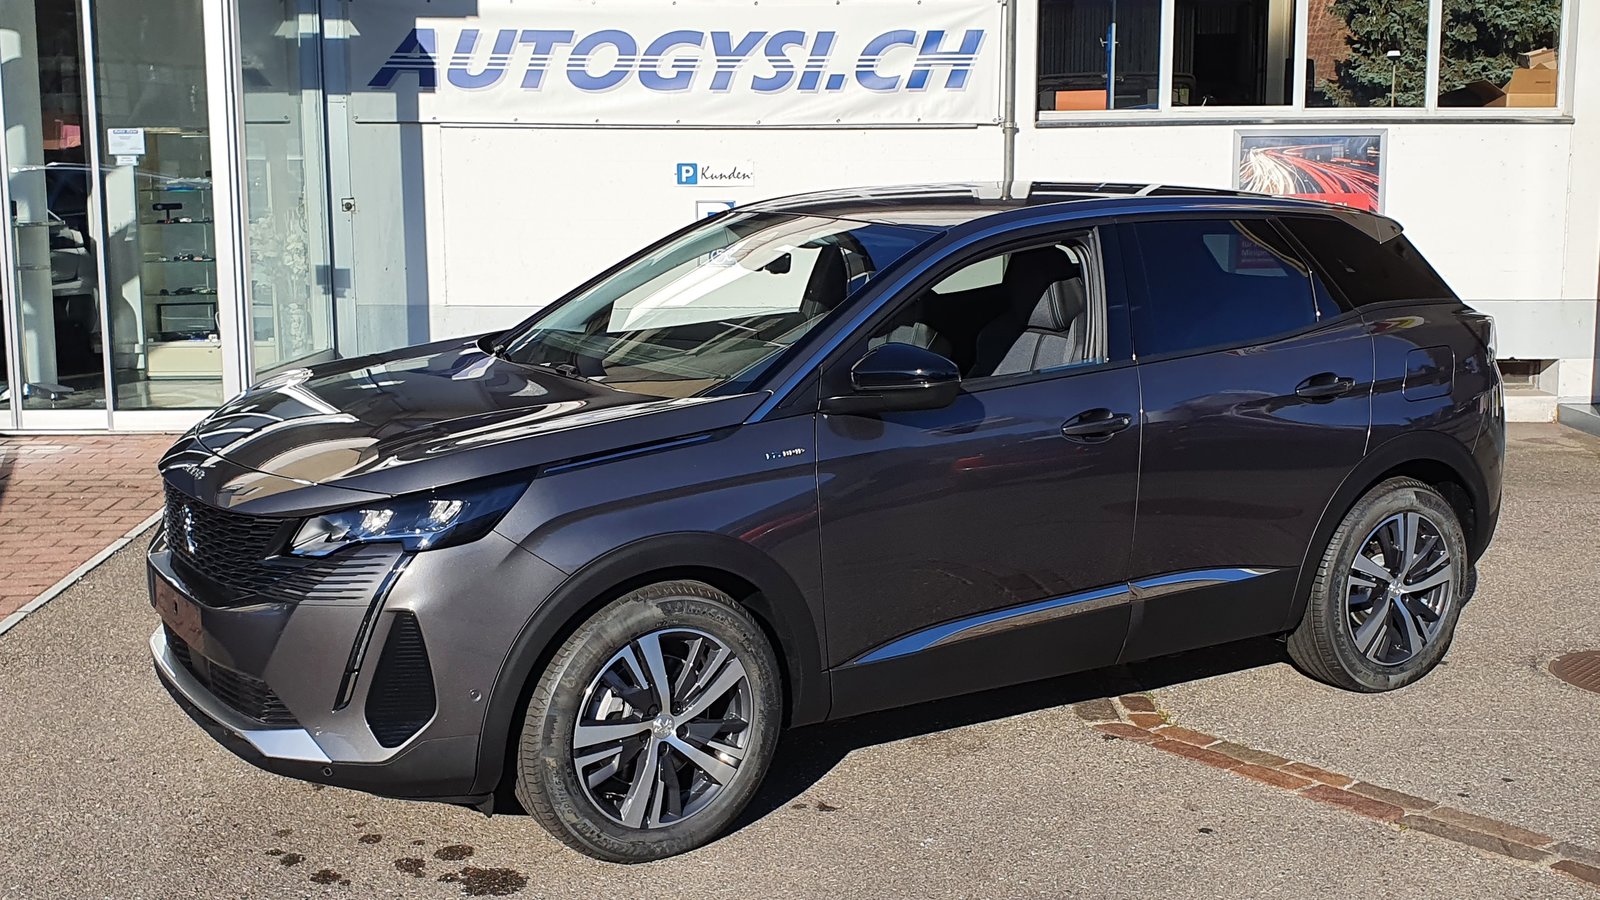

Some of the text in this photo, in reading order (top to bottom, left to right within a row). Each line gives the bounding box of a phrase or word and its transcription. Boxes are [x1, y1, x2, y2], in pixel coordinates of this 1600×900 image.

[367, 28, 986, 92] AUTOGYSI.CH
[681, 165, 751, 183] P Kunden
